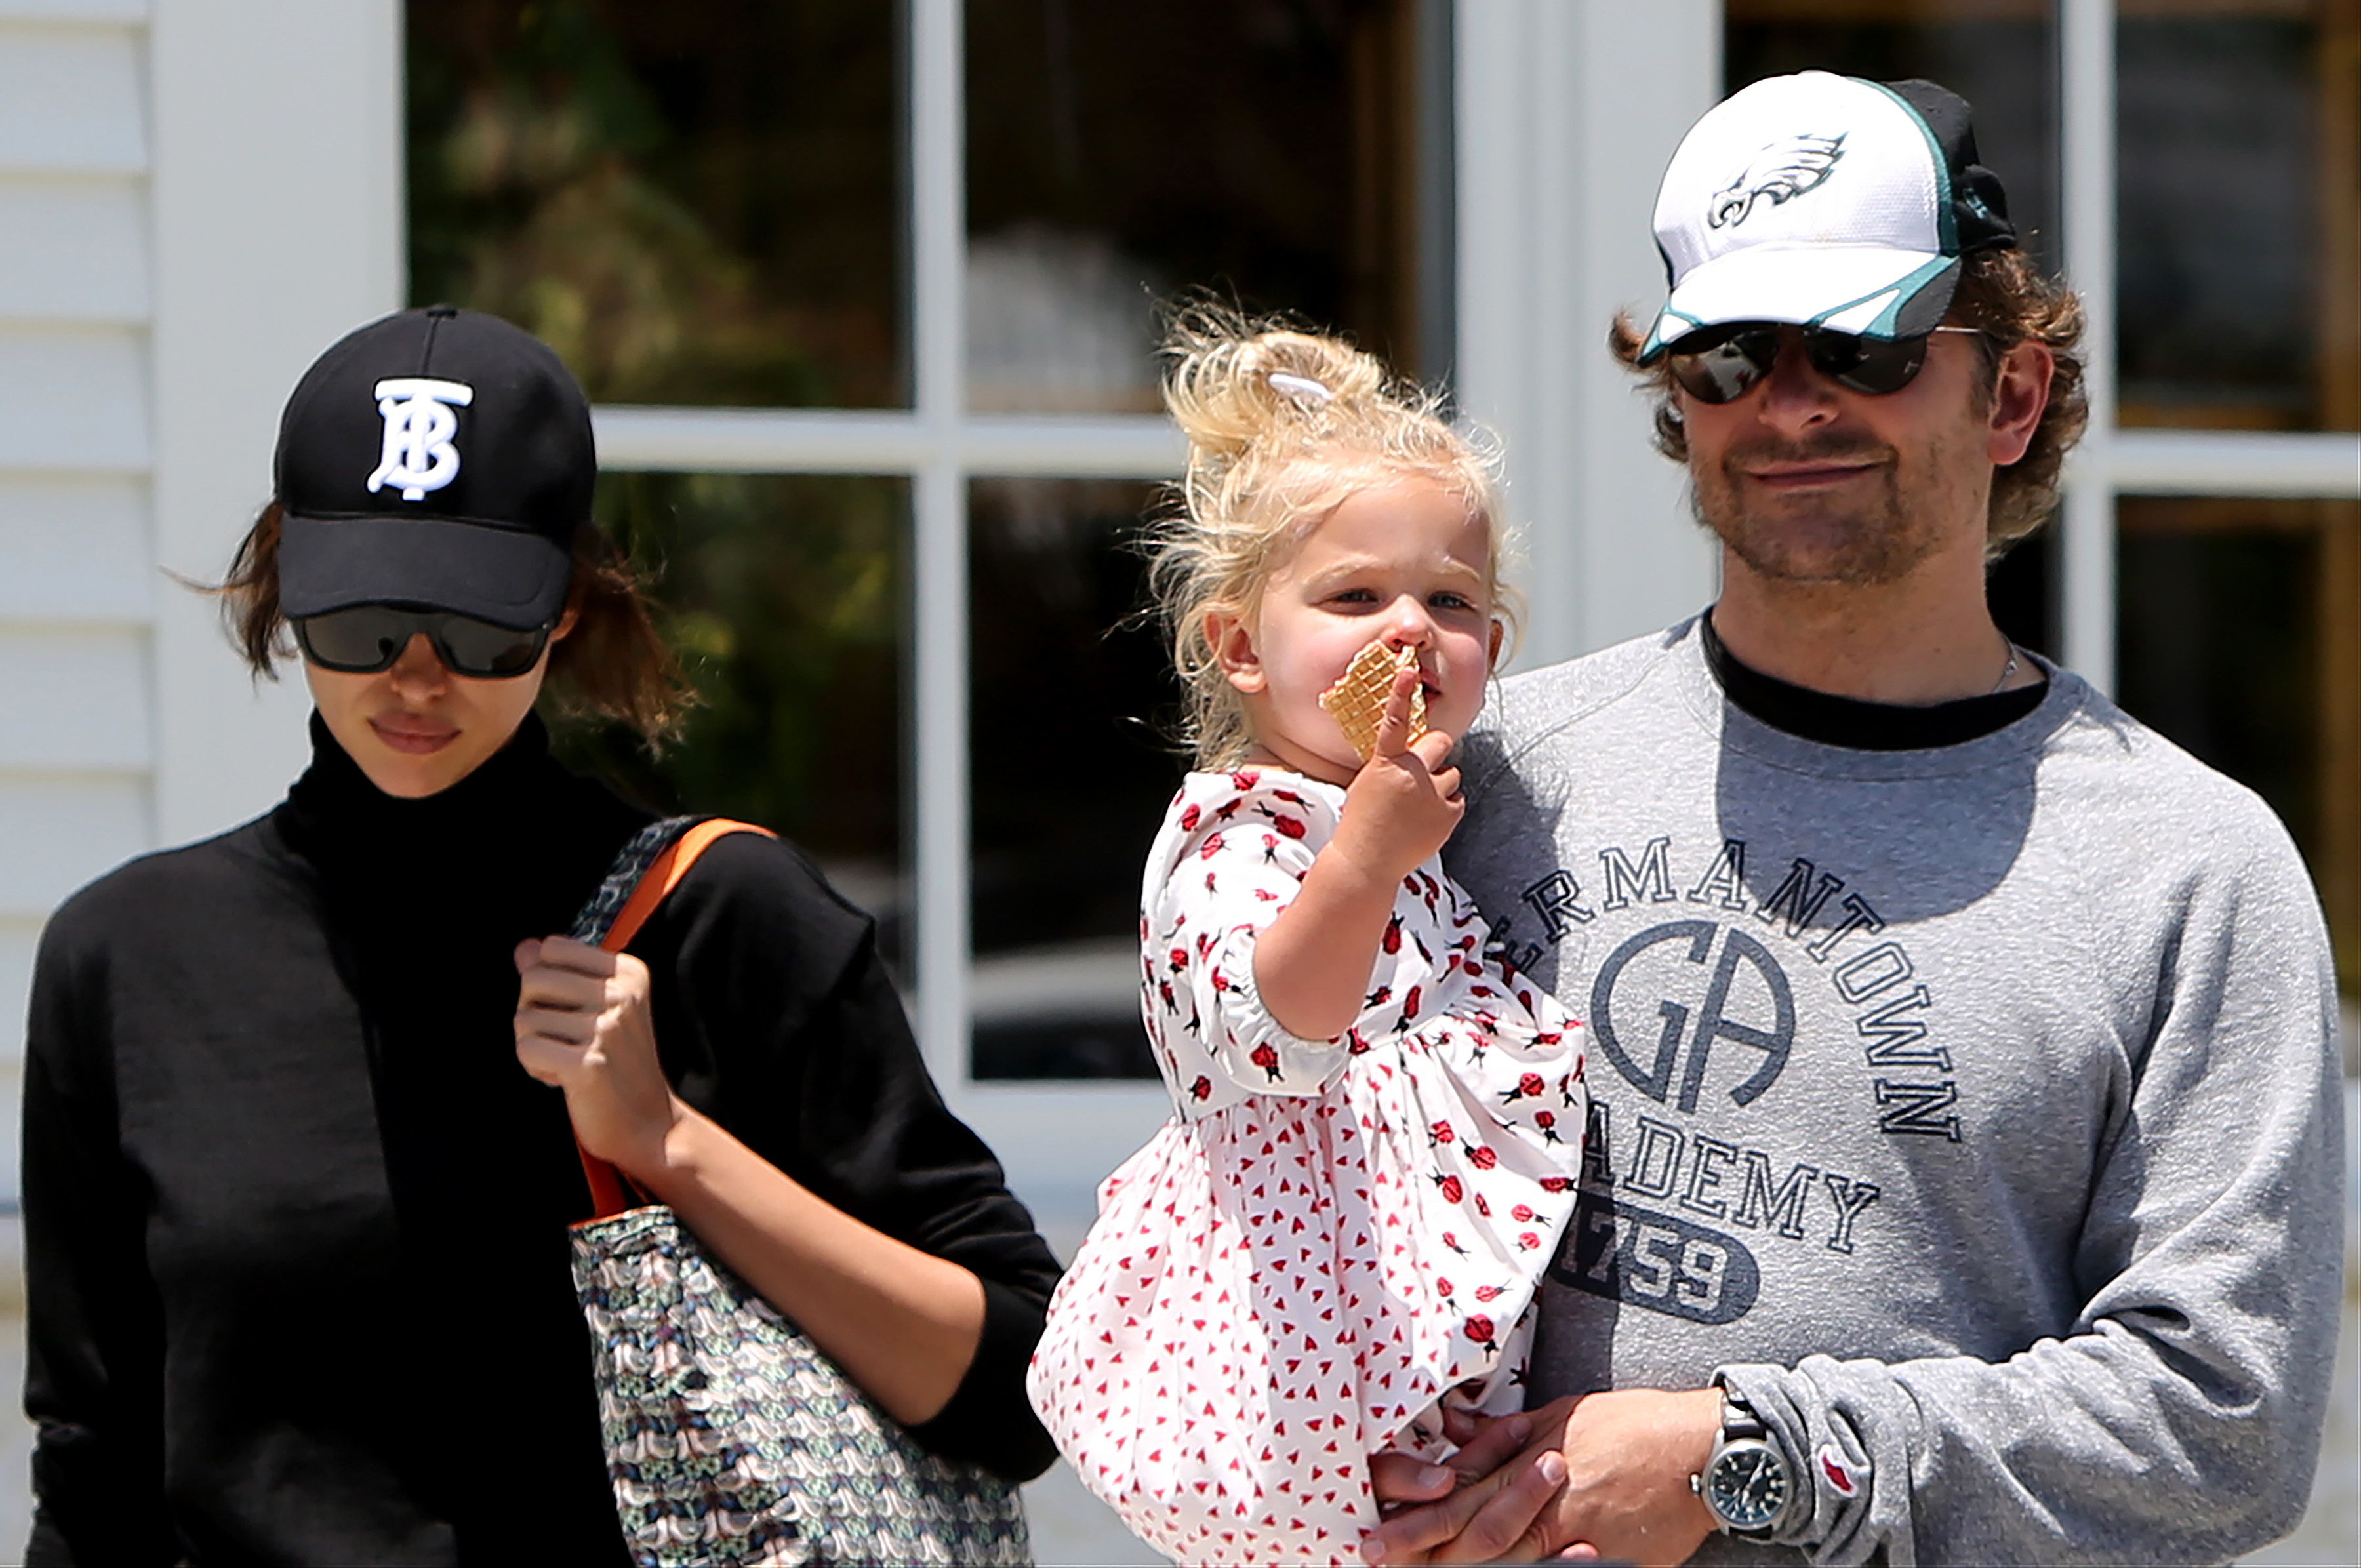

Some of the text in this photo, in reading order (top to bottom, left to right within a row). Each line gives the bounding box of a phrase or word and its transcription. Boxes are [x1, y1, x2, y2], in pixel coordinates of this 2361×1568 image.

[1485, 836, 1962, 1143] ERMANTOWN
[1579, 1100, 1880, 1255] ADEMY
[1558, 1205, 1729, 1312] 1759
